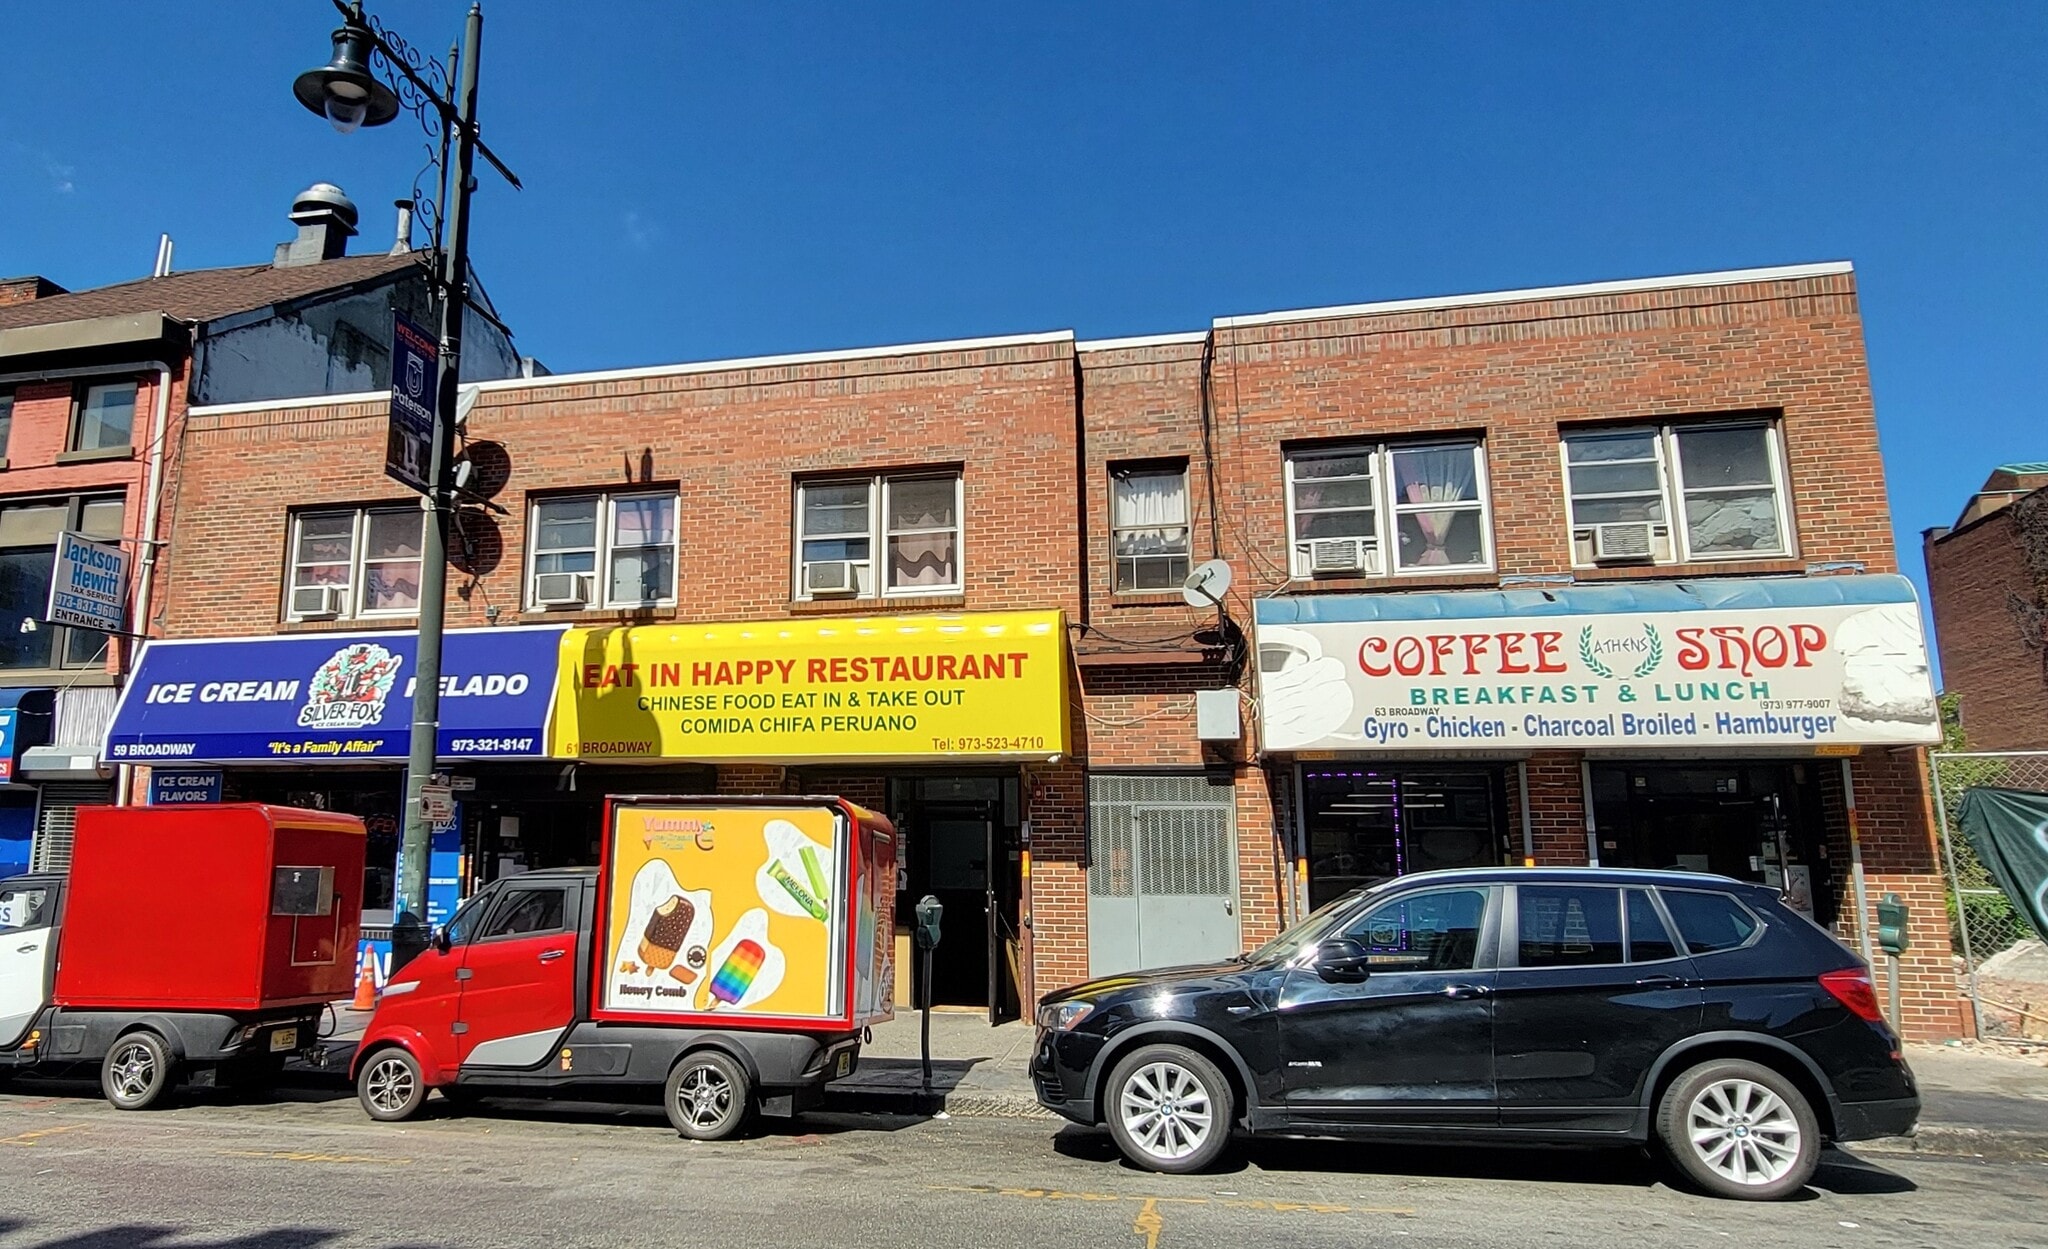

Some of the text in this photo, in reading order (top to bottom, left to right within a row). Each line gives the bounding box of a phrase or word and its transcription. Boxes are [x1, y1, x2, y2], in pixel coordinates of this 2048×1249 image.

[396, 321, 437, 358] WELCOME
[393, 383, 432, 423] Paterson
[64, 538, 121, 574] Jackson
[71, 562, 118, 596] Hewitt
[70, 585, 117, 604] TAX SERVICE
[55, 609, 104, 629] ENTRANCE
[1358, 624, 1827, 677] COFFEE SHOP
[1594, 636, 1648, 654] ATHENS
[583, 653, 1029, 689] EAT IN HAPPY RESTAURANT
[146, 680, 300, 704] ICE CREAM
[638, 690, 965, 711] CHINESE FOOD EAT IN & TAKE OUT
[1410, 681, 1771, 706] BREAKFAST & LUNCH
[300, 703, 382, 723] SILVER FOX
[1375, 706, 1440, 717] 63 BROADWAY
[1759, 699, 1831, 711] (973) 977-9007
[681, 715, 917, 734] COMIDA CHIFA PERUANO
[1363, 716, 1409, 744] Gyro
[1426, 715, 1506, 739] Chicken
[1523, 713, 1615, 738] Charcoal
[1622, 712, 1698, 736] Broiled
[1716, 711, 1838, 739] Hamburger
[113, 743, 196, 756] 59 BROADWAY
[293, 744, 301, 753] a
[303, 740, 342, 755] Family
[452, 738, 533, 751] 973-321-8147
[566, 741, 652, 754] 61 BROADWAY
[932, 737, 1044, 750] Tel: 973-523-4710
[158, 776, 215, 787] ICE CREAM
[160, 791, 208, 801] FLAVORS
[643, 816, 704, 836] Yummy
[785, 876, 814, 906] MELONA
[619, 984, 687, 1000] Honey Comb
